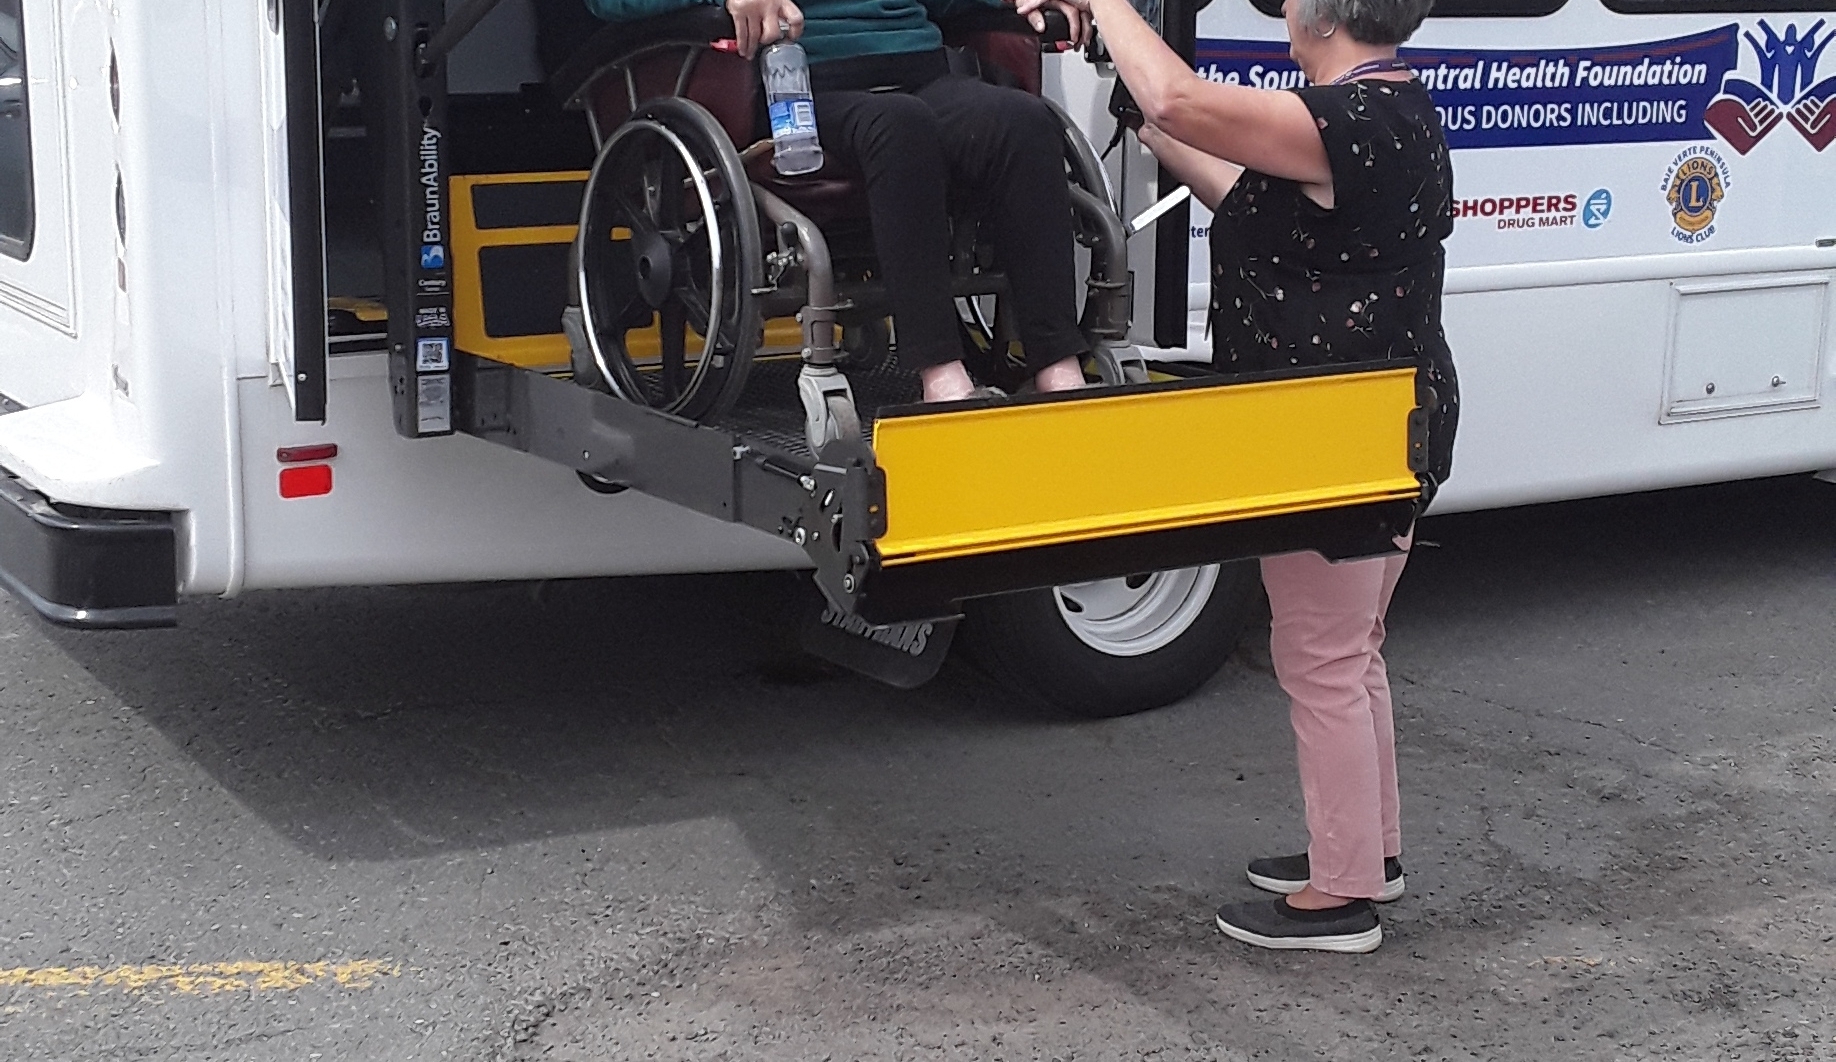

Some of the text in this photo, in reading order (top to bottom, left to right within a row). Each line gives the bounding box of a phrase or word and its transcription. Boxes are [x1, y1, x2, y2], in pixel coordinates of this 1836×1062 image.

[1195, 63, 1240, 86] the
[1248, 64, 1315, 89] Sout
[1488, 56, 1568, 88] Health
[1575, 56, 1707, 87] Foundation
[1481, 102, 1572, 129] DONORS
[1577, 99, 1687, 126] INCLUDING
[1660, 146, 1731, 191] BAIE VERTE PENINSULA
[1681, 160, 1714, 177] LIONS
[420, 127, 442, 243] BraunAbility
[1688, 181, 1704, 207] L
[1451, 194, 1577, 218] SHOPPERS
[1497, 215, 1577, 230] DRUG MART
